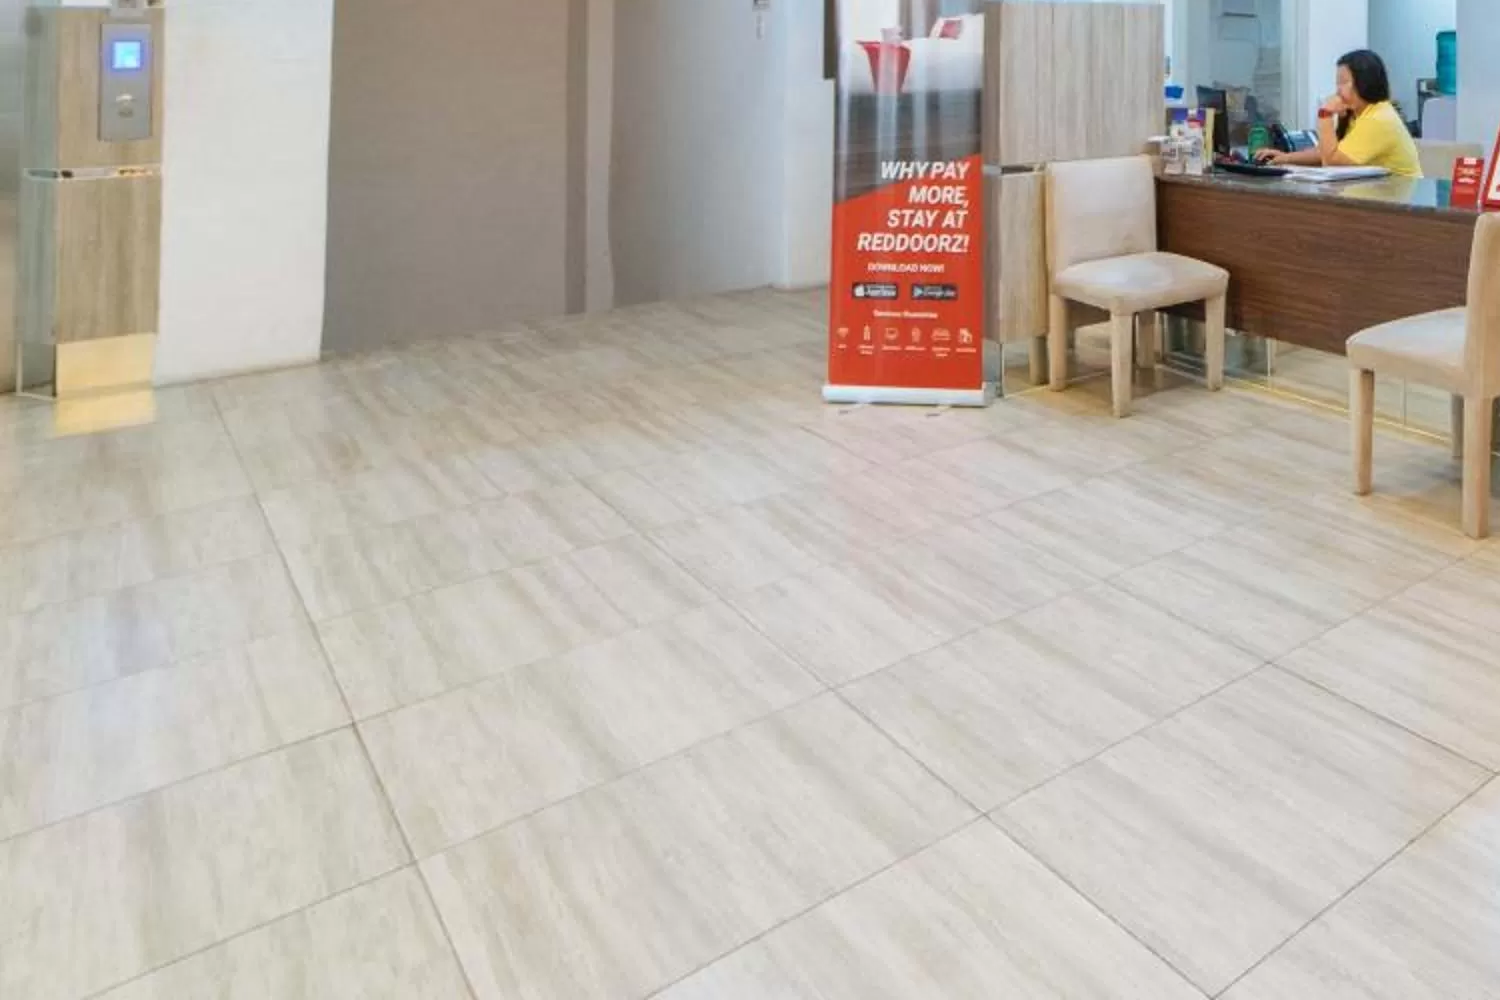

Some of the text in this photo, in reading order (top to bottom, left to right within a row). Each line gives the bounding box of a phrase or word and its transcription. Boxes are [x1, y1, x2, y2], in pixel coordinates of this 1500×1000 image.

[881, 161, 970, 180] WHY PAY
[909, 185, 969, 208] MORE,
[887, 209, 968, 228] STAY AT
[857, 232, 970, 252] REDDOORZ!
[868, 262, 918, 273] DOWNLOAD
